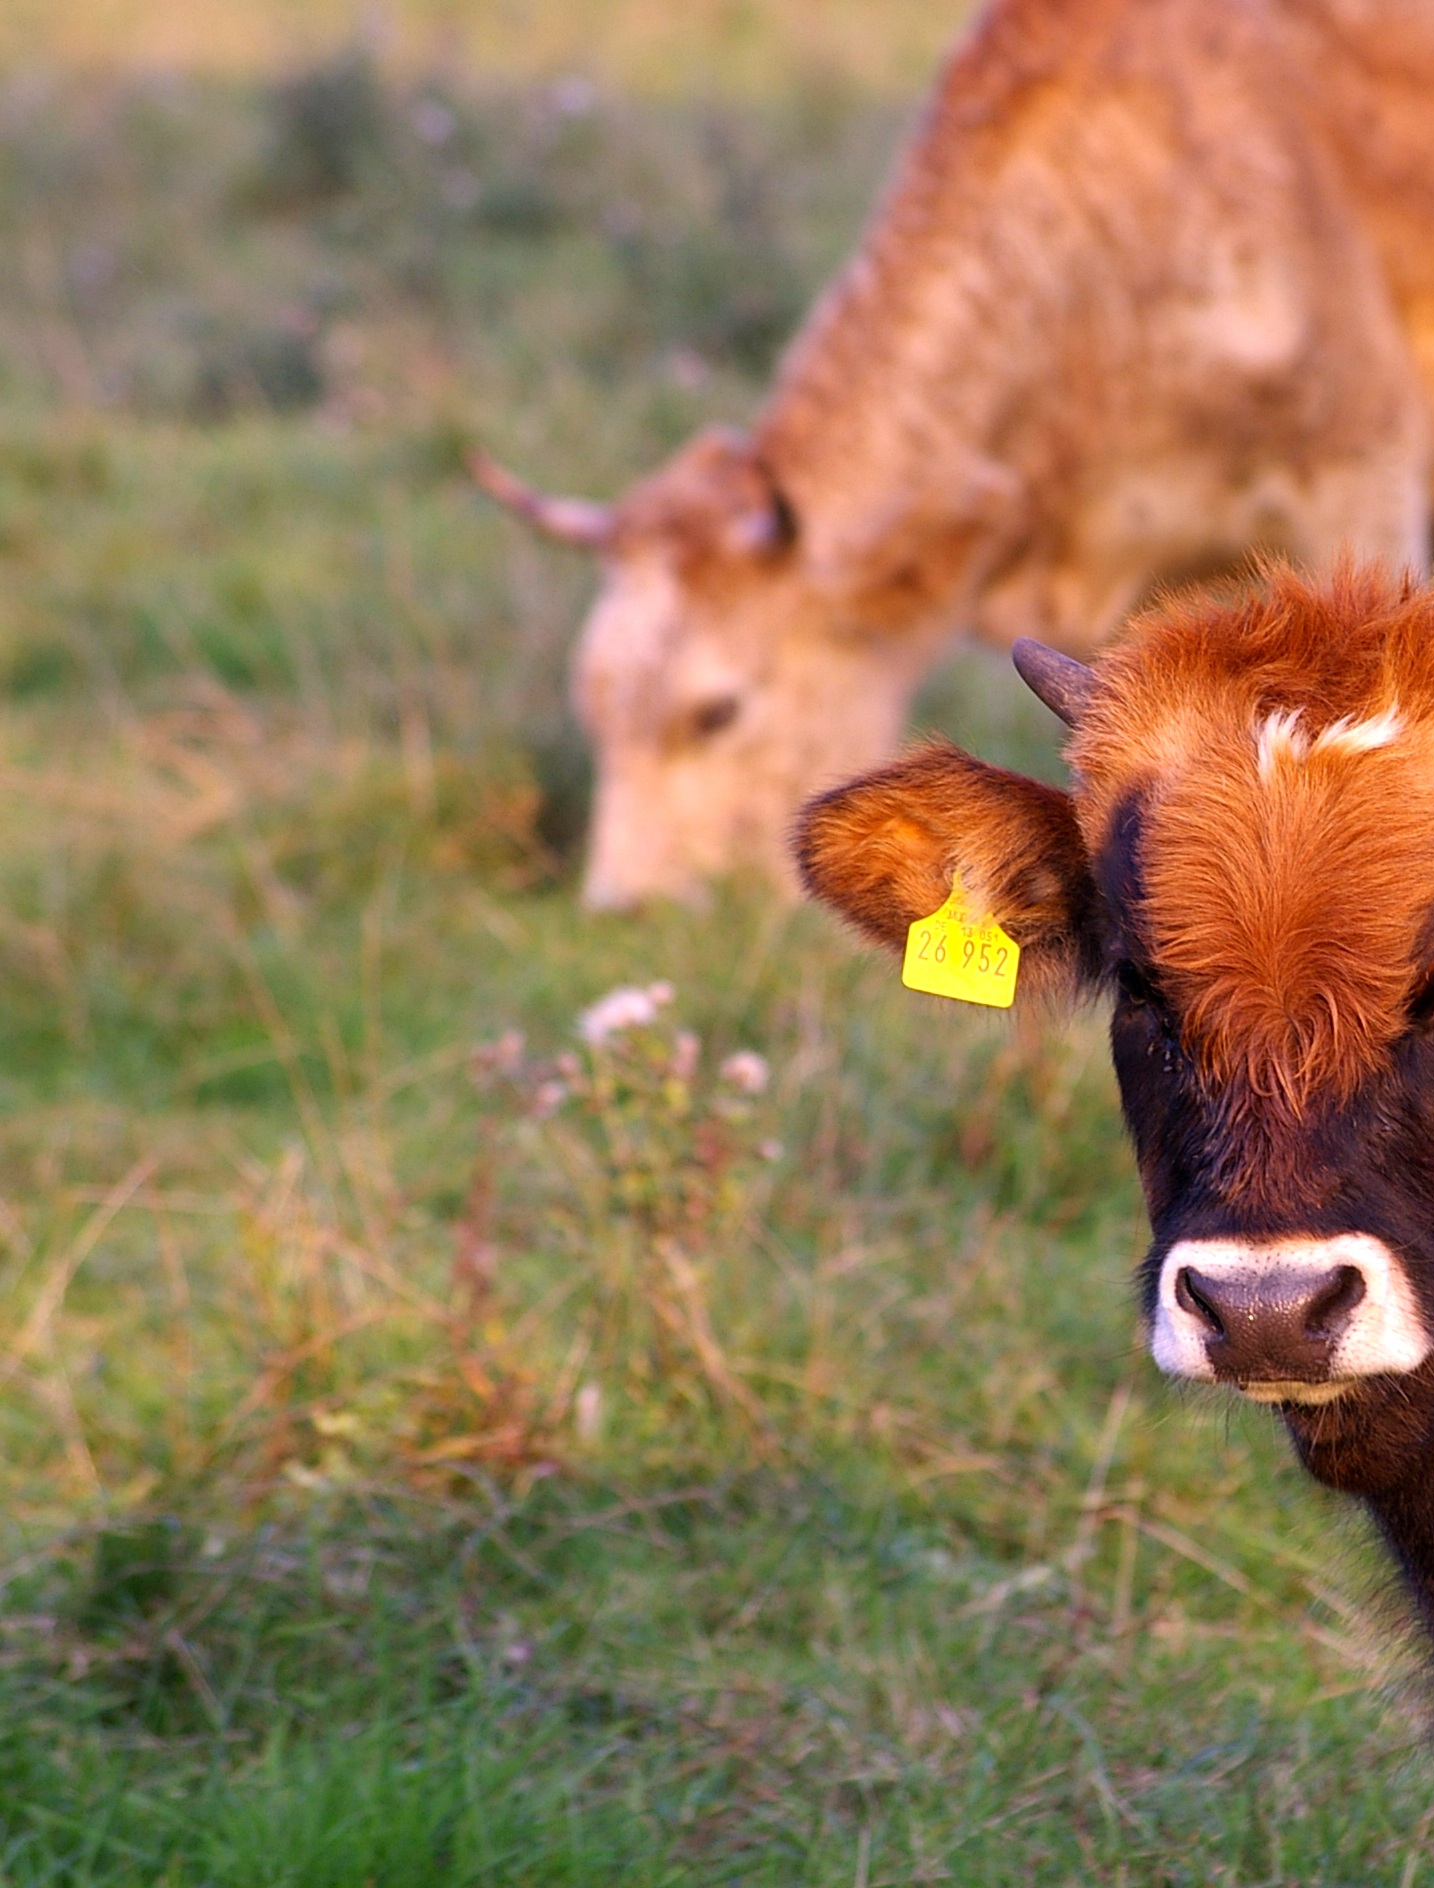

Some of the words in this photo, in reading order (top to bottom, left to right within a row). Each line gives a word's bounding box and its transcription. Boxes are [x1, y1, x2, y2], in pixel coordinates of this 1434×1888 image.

[979, 930, 999, 942] 051
[917, 930, 948, 964] 26
[962, 940, 1009, 977] 952
